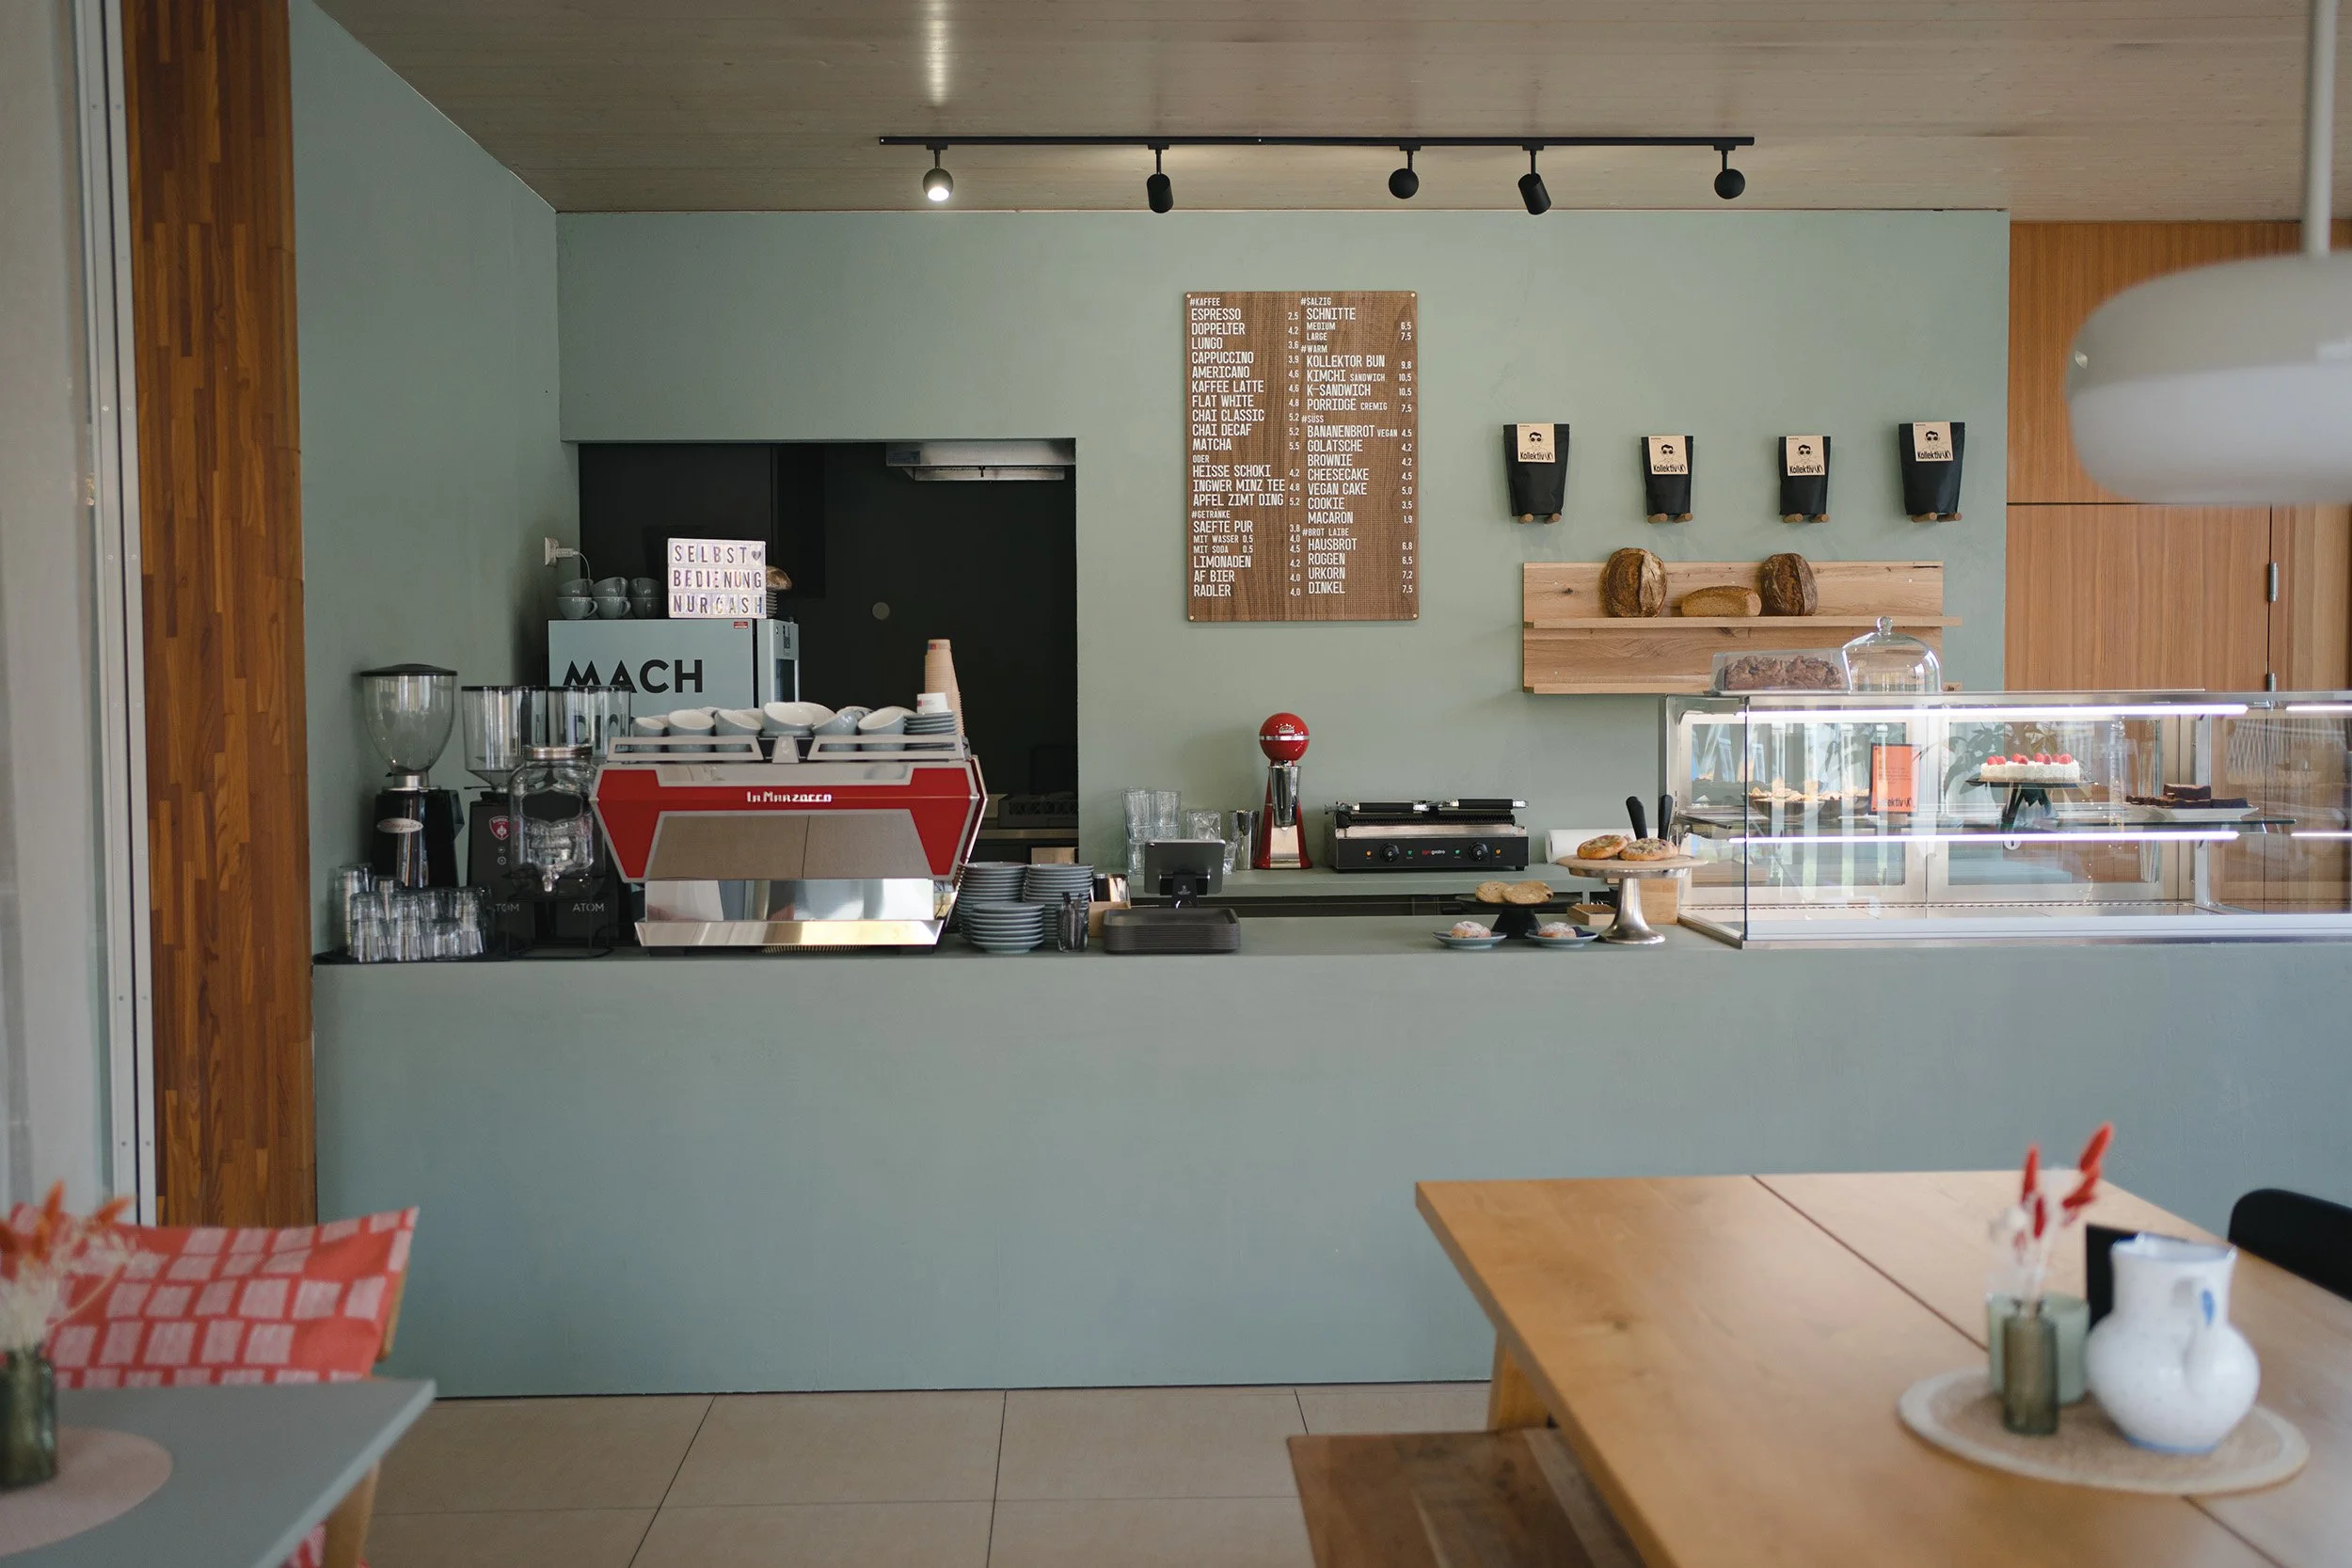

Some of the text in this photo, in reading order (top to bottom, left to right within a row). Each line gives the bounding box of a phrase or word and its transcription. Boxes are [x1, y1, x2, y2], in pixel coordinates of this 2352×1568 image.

[1189, 297, 1220, 306] #KAFFEE
[1301, 297, 1331, 306] #SALZIG
[1191, 309, 1241, 320] ESPRESSO
[1307, 308, 1356, 320] SCHNITTE
[1191, 323, 1245, 335] DOPPELTER
[1307, 322, 1411, 330] MEDIUM 6.5
[1307, 332, 1411, 341] LARGE 7.5
[1191, 337, 1298, 349] LUNGO 3.6
[1191, 352, 1254, 364] CAPPUCCINO
[1307, 355, 1362, 367] KOLLEKTOR
[1366, 355, 1385, 367] BUN
[1192, 366, 1249, 378] AMERICANO
[1307, 370, 1345, 382] KIMCHI
[1350, 373, 1385, 382] SANDWICH
[1192, 380, 1299, 392] KAFFEE LATTE 4.6
[1307, 384, 1411, 396] K-SANDWICH 10.5
[1192, 395, 1216, 407] FLAT
[1221, 395, 1254, 407] WHITE
[1307, 399, 1357, 410] PORRIDGE
[1402, 404, 1412, 413] 7.5
[1192, 409, 1299, 421] CHAI CLASSIC 5.2
[1192, 424, 1217, 436] CHAI
[1221, 424, 1252, 436] DECAF
[1308, 425, 1412, 437] BANANENBROT VEGAN 4.5
[1193, 438, 1232, 451] MATCHA
[1308, 439, 1363, 451] GOLATSCHE
[1308, 454, 1412, 467] BROWNIE 4.2
[1193, 465, 1230, 477] HEISSE
[1234, 465, 1271, 477] SCHOKI
[1308, 468, 1369, 481] CHEESECAKE
[1193, 480, 1232, 491] INGWER
[1236, 480, 1263, 491] MINZ
[1267, 479, 1285, 491] TEE
[1308, 483, 1412, 495] VEGAN CAKE 5.0
[1193, 494, 1224, 506] APFEL
[1228, 494, 1254, 506] ZIMT
[1259, 494, 1283, 506] DING
[1308, 498, 1412, 509] COOKIE 3.5
[1308, 512, 1353, 524] MACARON
[1193, 521, 1300, 532] SAEFTE PUR 3.8
[1302, 528, 1349, 536] #BROT LAIBE
[1290, 534, 1300, 543] 4.0
[1308, 538, 1413, 550] HAUSBROT 6.8
[675, 545, 747, 563] SELBST
[1290, 545, 1300, 553] 4.5
[1193, 556, 1251, 568] LIMONADEN
[1309, 553, 1345, 564] ROGGEN
[674, 569, 761, 588] BEDIENUNG
[1194, 570, 1206, 582] AF
[1210, 570, 1235, 582] BIER
[1309, 567, 1345, 579] URKORN
[1194, 584, 1300, 596] RADLER 4.0
[1309, 581, 1413, 594] DINKEL 7.5
[563, 659, 703, 693] MACH
[572, 903, 605, 912] ATOM
